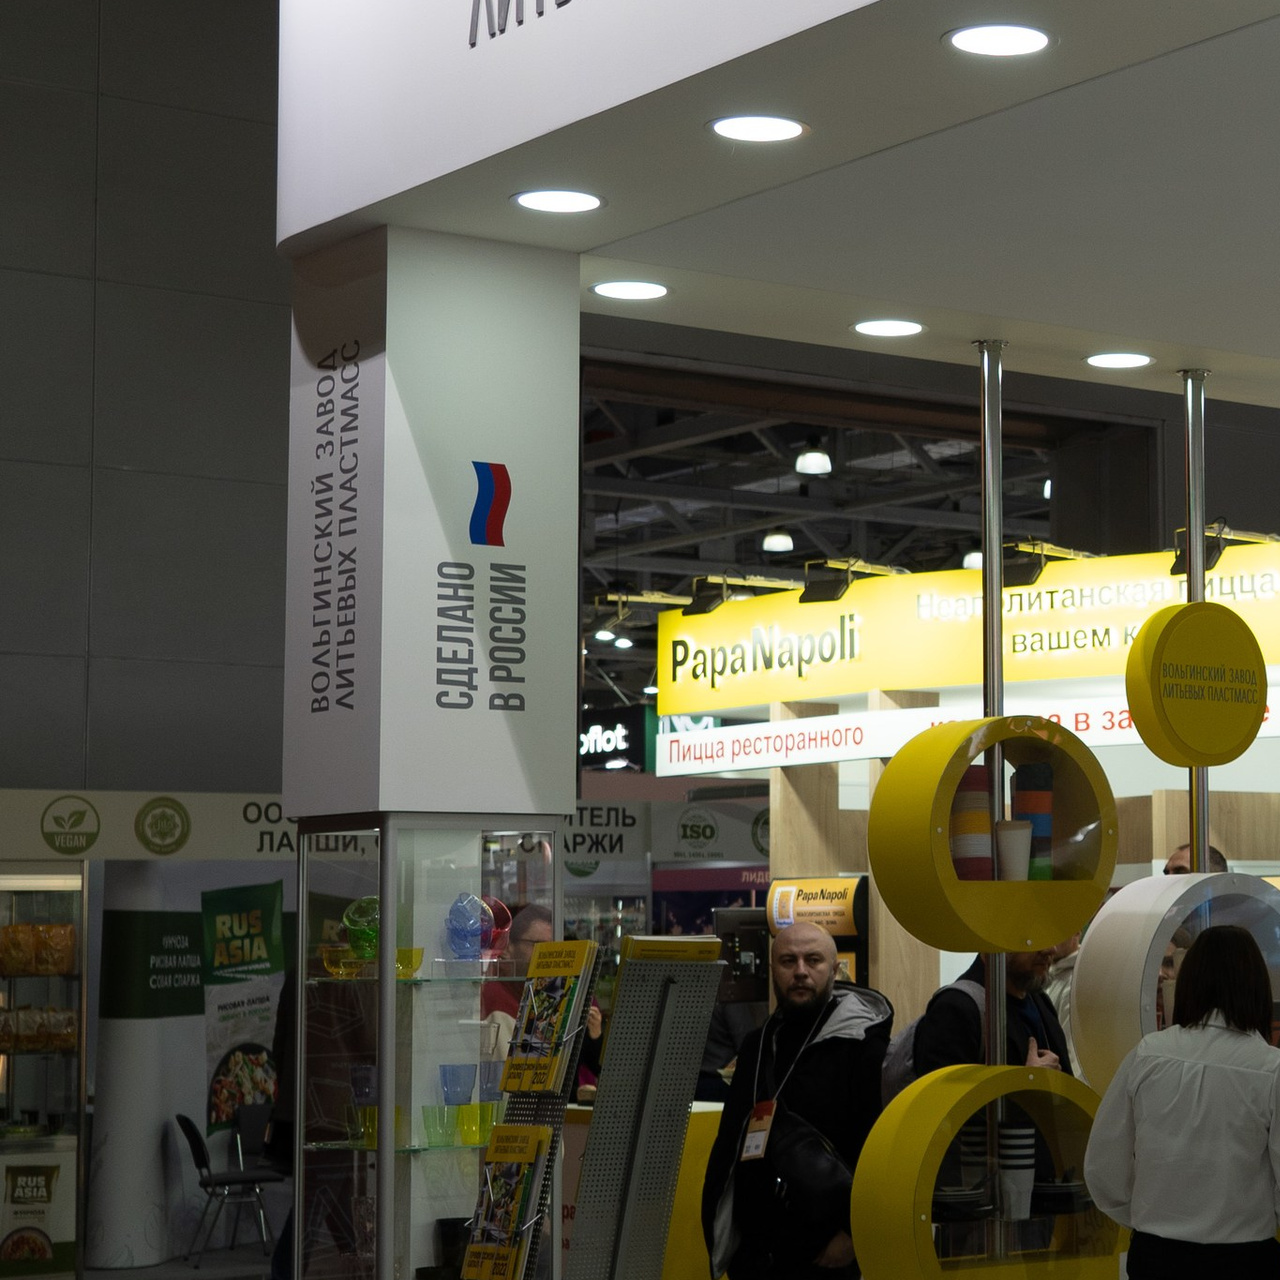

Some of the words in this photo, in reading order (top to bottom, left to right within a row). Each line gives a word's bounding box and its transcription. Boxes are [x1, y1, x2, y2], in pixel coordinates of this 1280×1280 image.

[315, 348, 339, 460] ЗАВОД
[337, 339, 360, 538] ПЛАСТМАСС
[310, 472, 334, 713] ВОЛЬГИНСКИЙ
[335, 546, 357, 710] ЛИТЬЕВЫХ
[436, 561, 478, 710] СДЕЛАНО
[489, 563, 526, 683] РОССИИ
[1012, 627, 1111, 653] вашем
[1163, 663, 1226, 687] ВОЛЬГИНСКИЙ
[1229, 667, 1257, 687] ЗАВОД
[489, 693, 525, 711] В
[1163, 684, 1204, 700] ЛИТЬЕВЫХ
[1207, 685, 1258, 704] ПЛАСТМАСС
[669, 739, 724, 765] Пицца
[732, 726, 864, 763] ресторанного
[54, 834, 86, 848] VEGAN
[681, 824, 715, 839] ISO
[215, 909, 262, 938] RUS
[214, 936, 269, 968] ASIA
